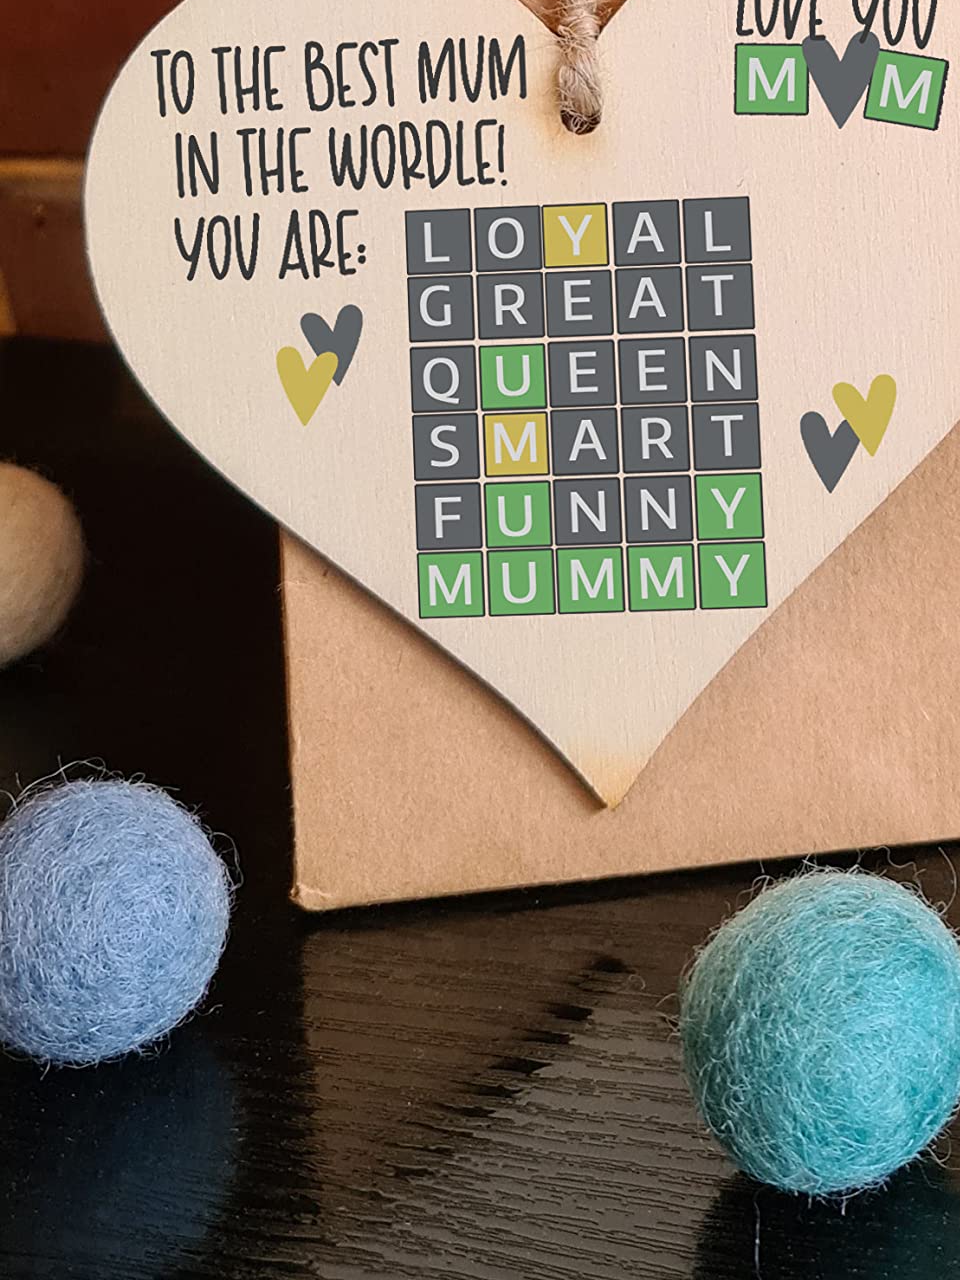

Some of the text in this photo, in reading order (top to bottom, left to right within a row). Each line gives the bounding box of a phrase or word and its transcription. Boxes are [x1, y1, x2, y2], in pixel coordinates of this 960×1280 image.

[150, 34, 528, 117] TO THE BEST MUM
[175, 119, 508, 198] IN THE WORDLE!
[174, 209, 367, 282] YOU ARE:
[424, 210, 731, 263] LOYAL
[419, 274, 734, 327] GREAT
[422, 349, 742, 405] QUEEN
[429, 414, 744, 468] SMART
[434, 487, 746, 539] FUNNY
[428, 554, 751, 607] MUMMY
